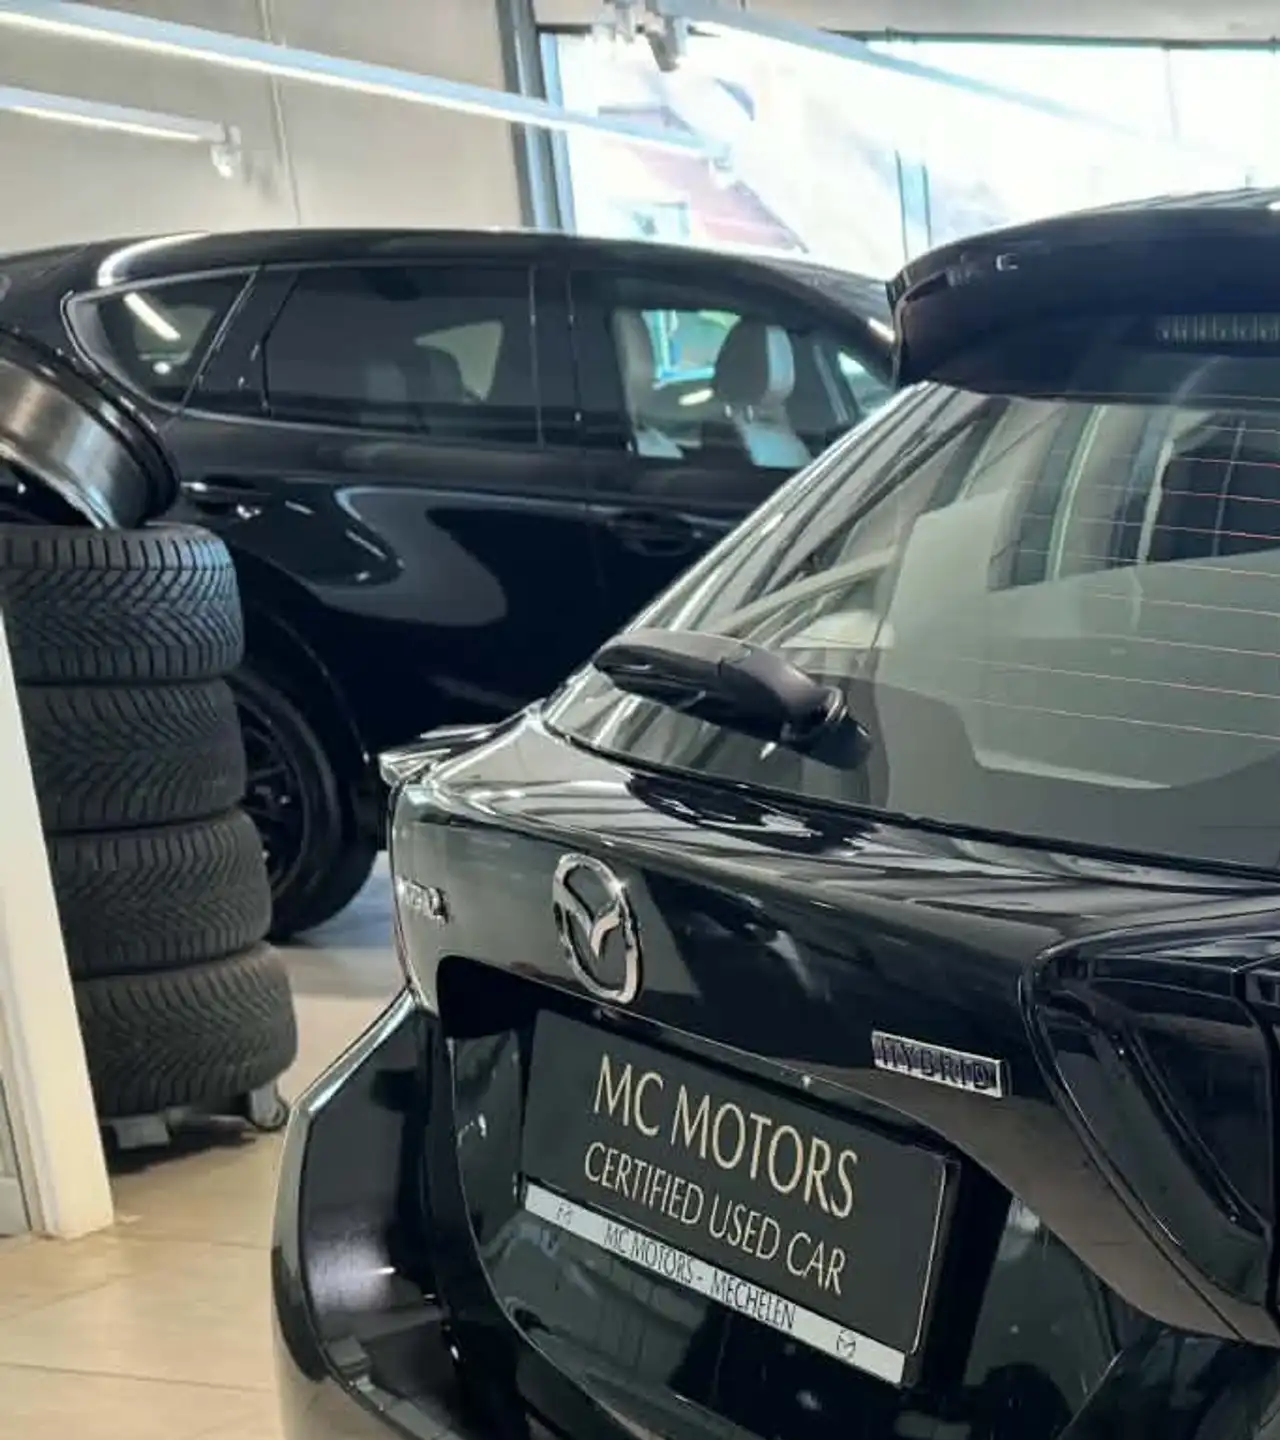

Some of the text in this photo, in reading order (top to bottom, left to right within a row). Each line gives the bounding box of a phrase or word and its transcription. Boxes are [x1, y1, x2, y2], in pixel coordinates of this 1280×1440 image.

[873, 1034, 995, 1092] HYBRID
[593, 1053, 859, 1220] MC MOTORS
[583, 1140, 847, 1297] CERTIFIED USED CAR
[603, 1222, 632, 1255] MC
[631, 1233, 694, 1287] MOTORS
[710, 1269, 798, 1331] MECHELEN
